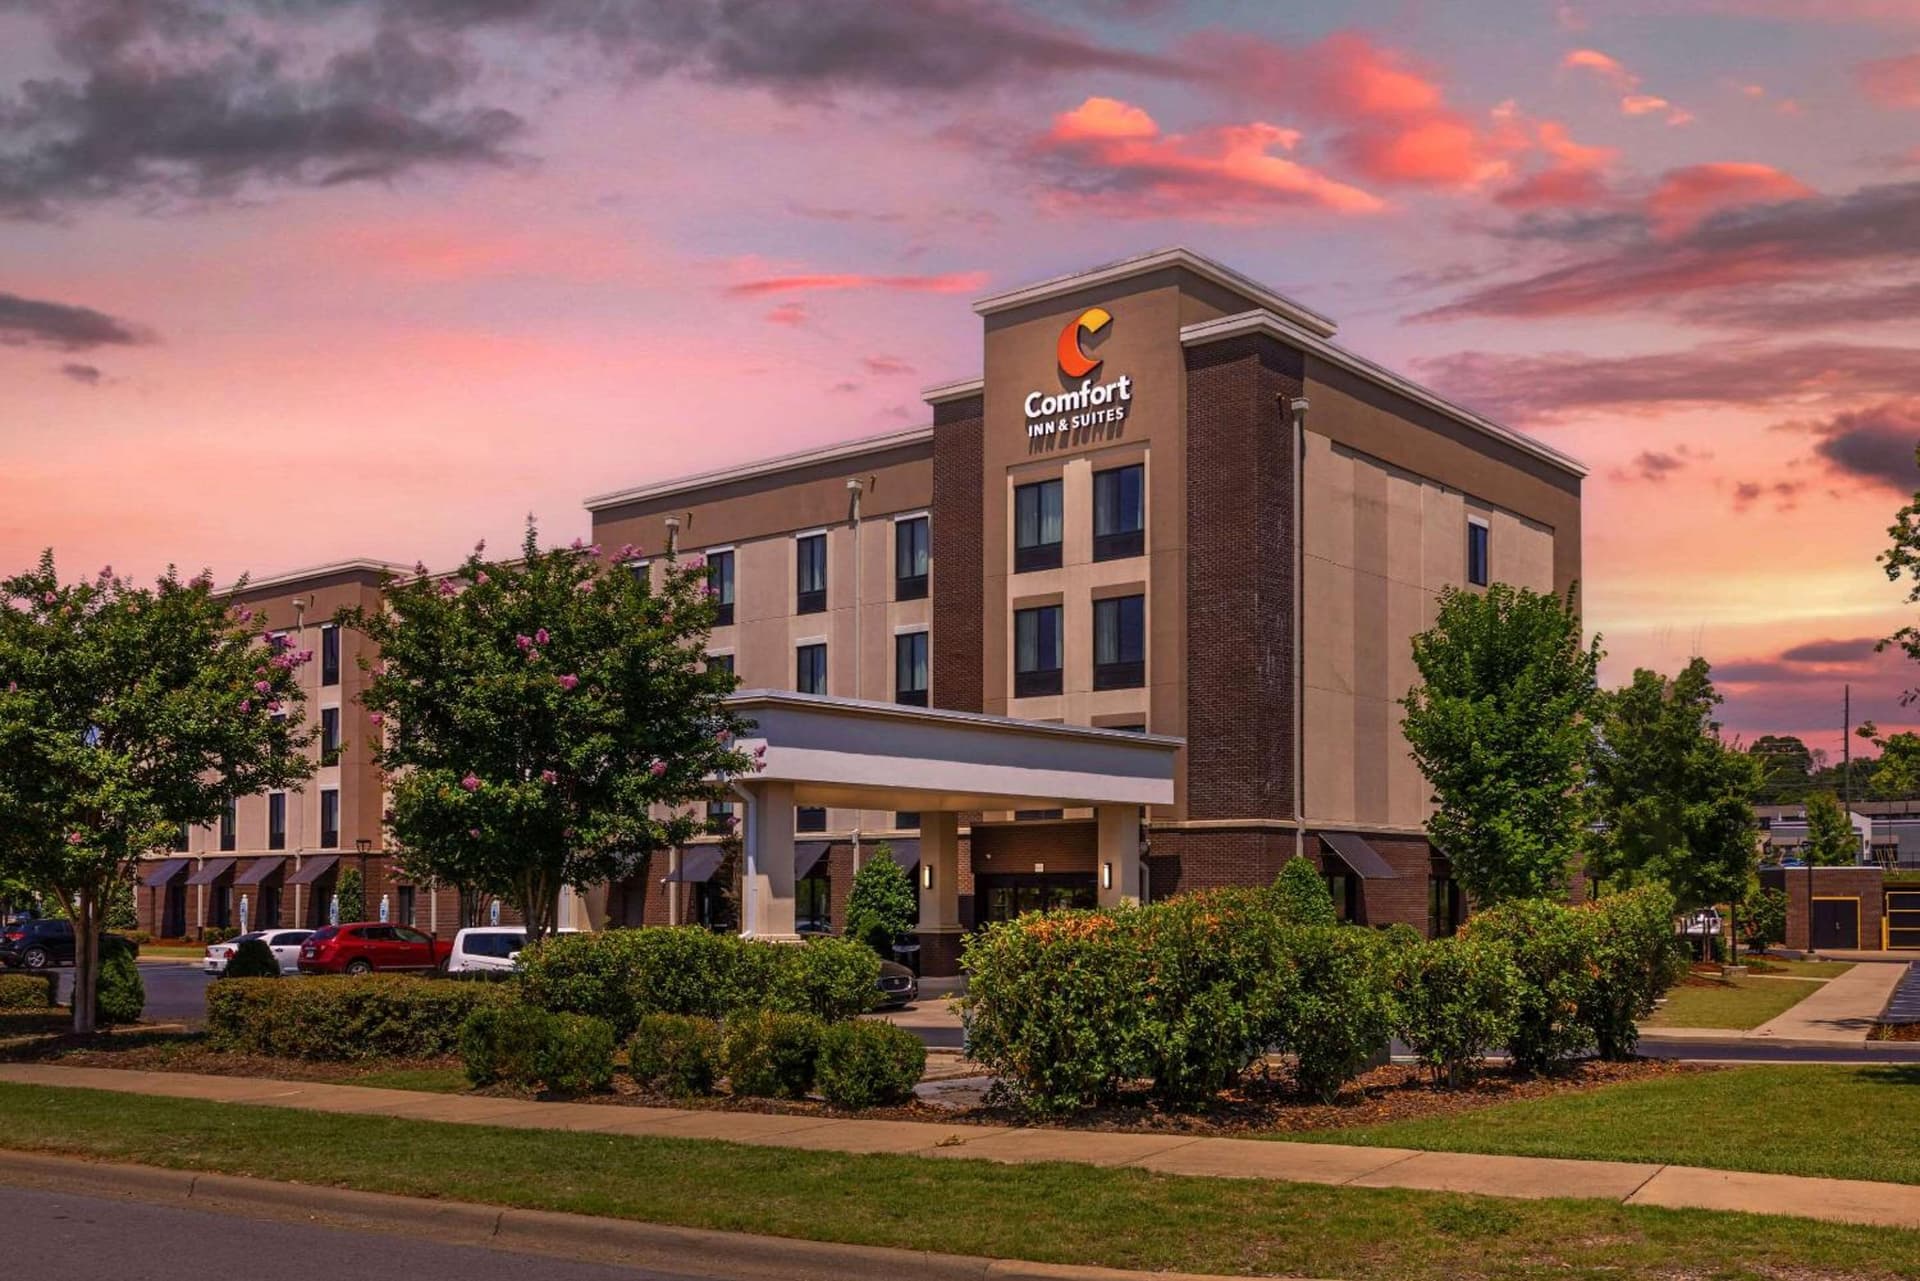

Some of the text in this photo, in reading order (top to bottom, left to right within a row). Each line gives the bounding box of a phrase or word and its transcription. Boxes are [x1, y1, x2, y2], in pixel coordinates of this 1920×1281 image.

[1024, 375, 1131, 418] Comfort
[1028, 407, 1124, 437] INN & SUITES
